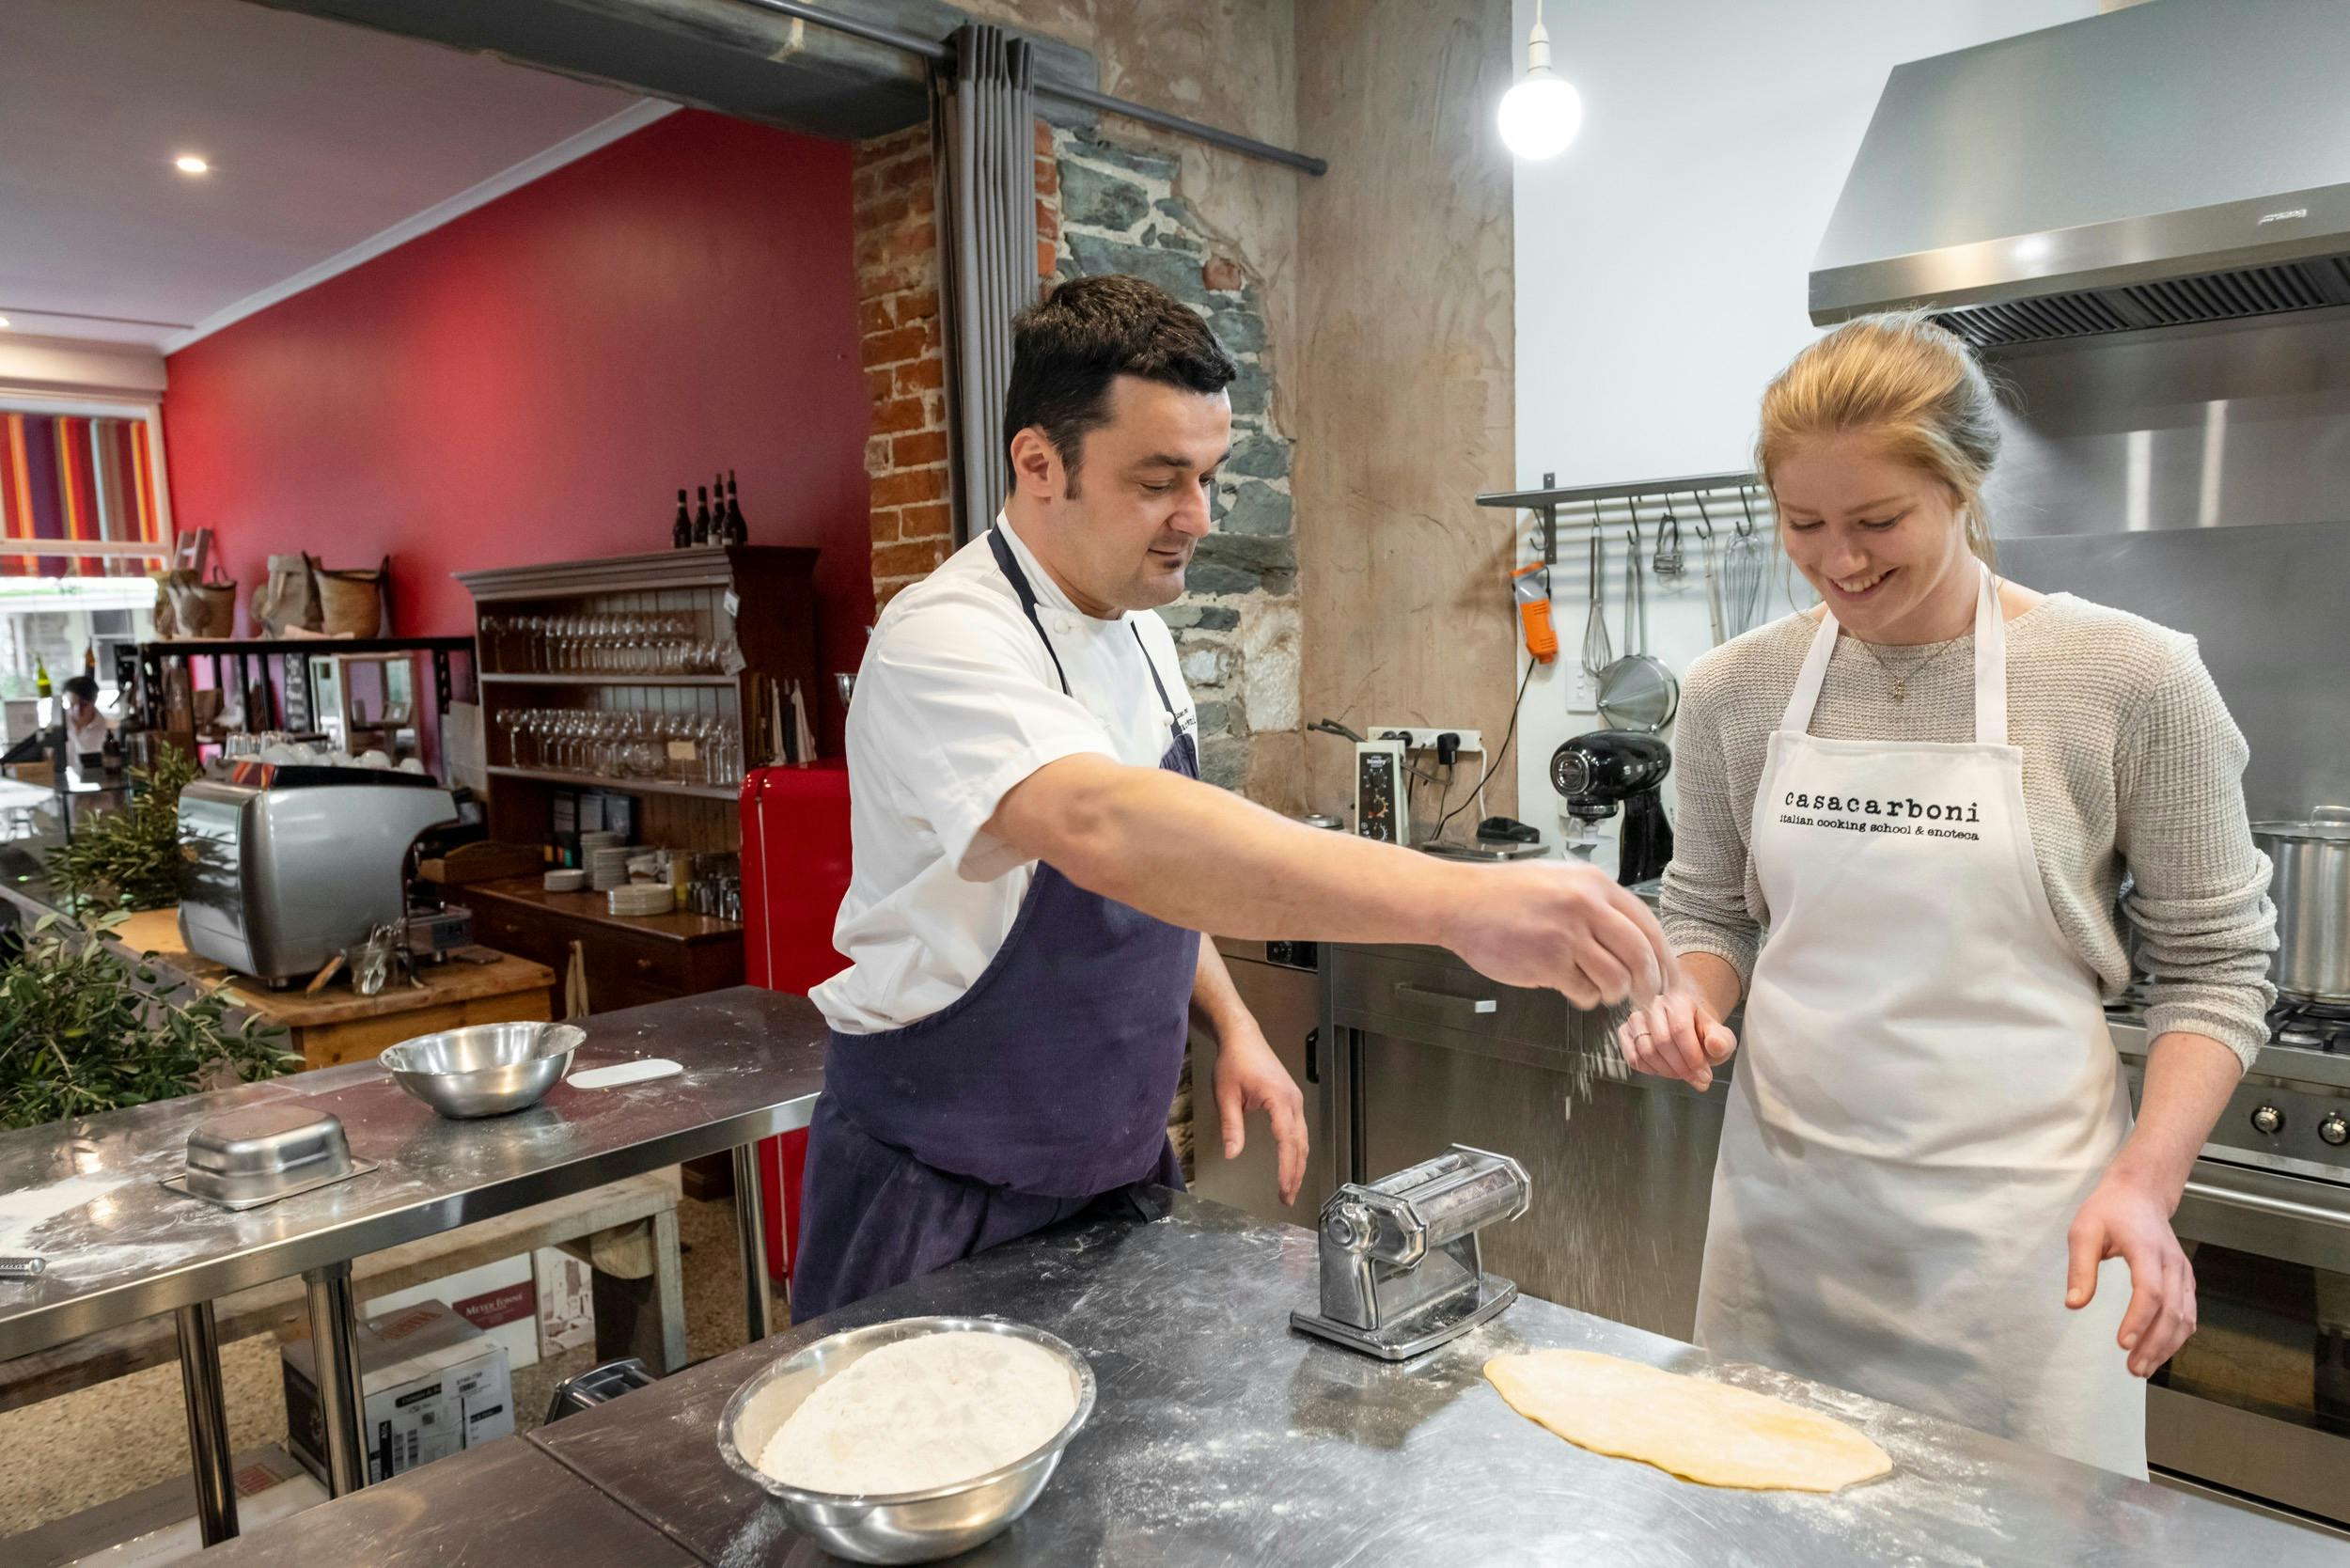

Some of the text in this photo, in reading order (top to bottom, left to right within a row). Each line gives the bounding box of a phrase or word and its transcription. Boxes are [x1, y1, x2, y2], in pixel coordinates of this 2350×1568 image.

[1785, 792, 1981, 823] casacarboni
[1779, 813, 1980, 841] italian cooking school & enoteca
